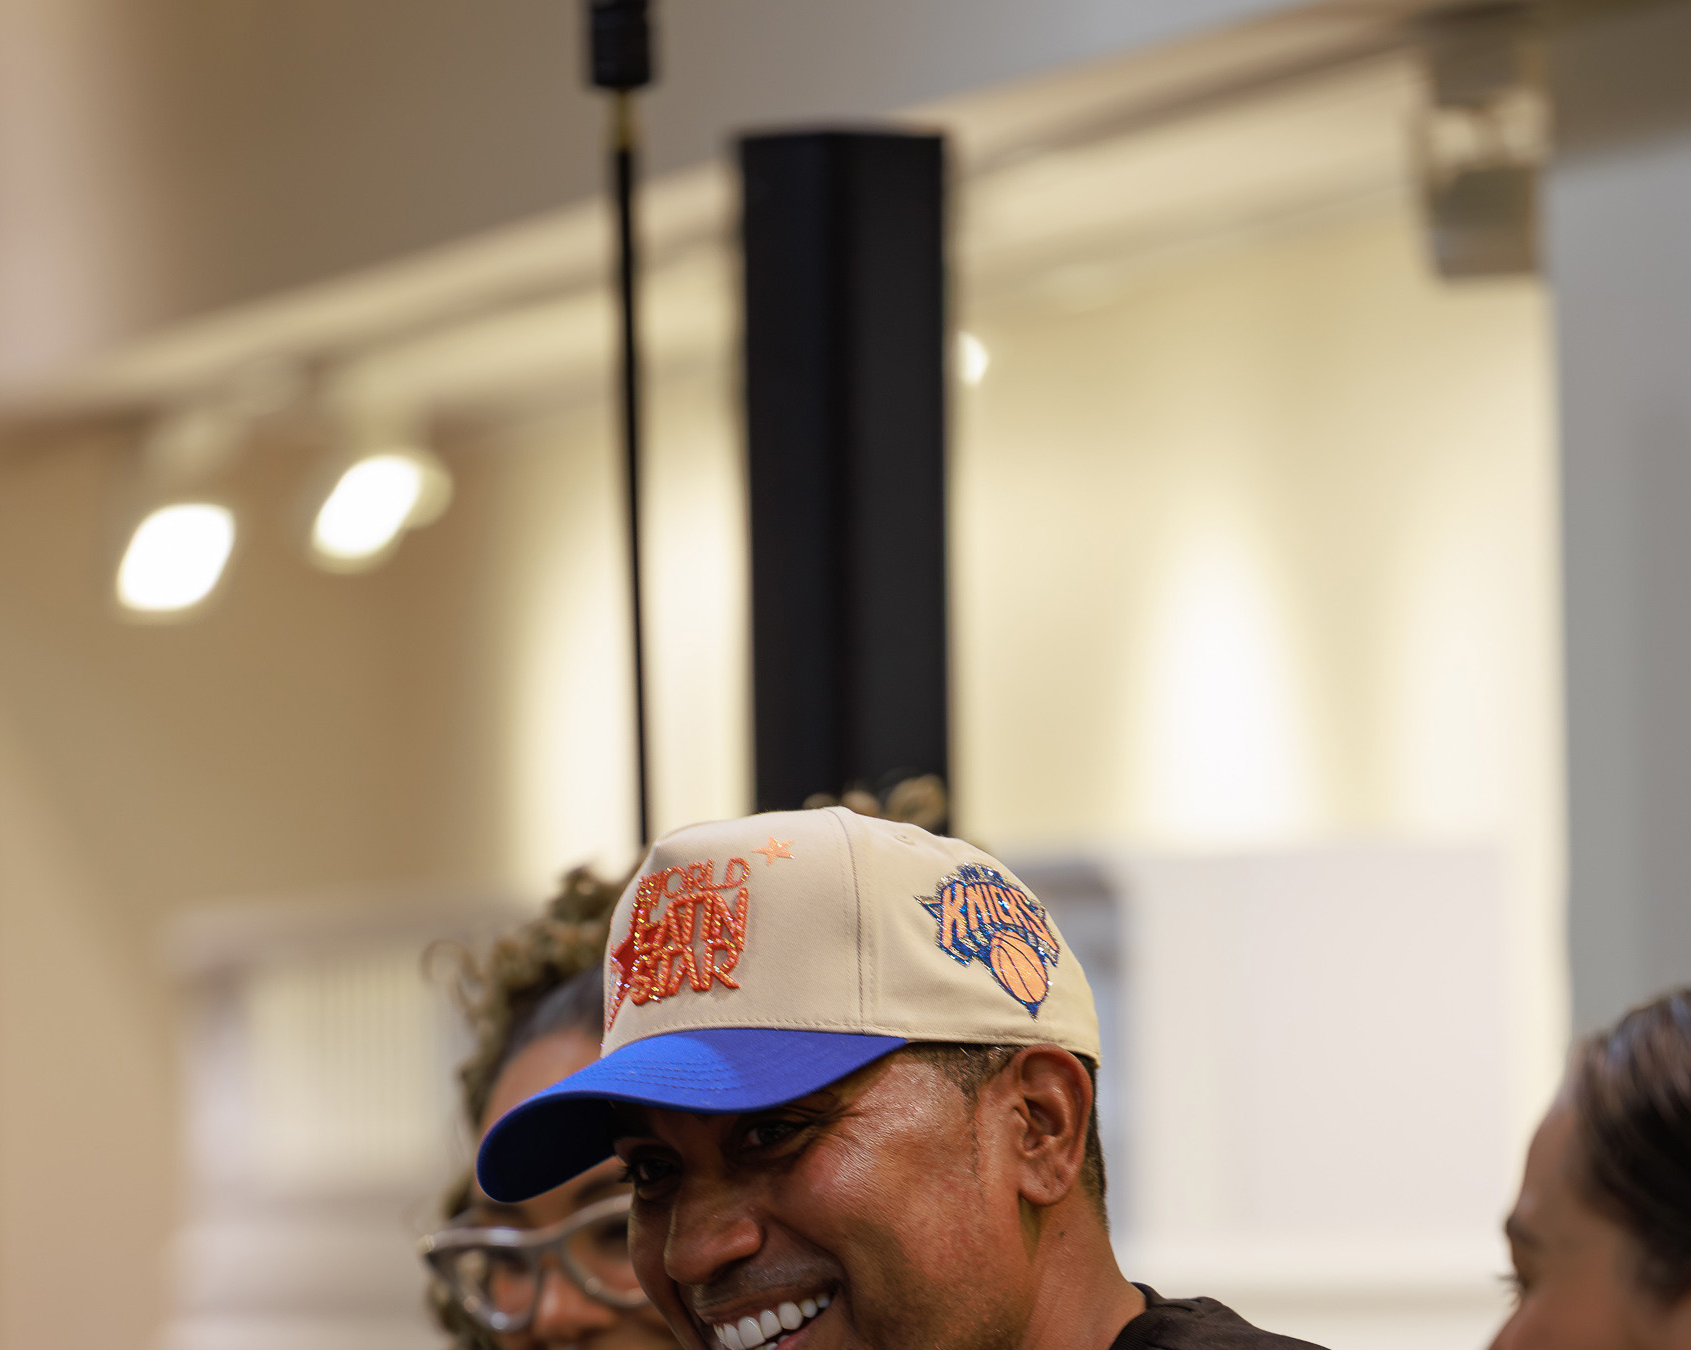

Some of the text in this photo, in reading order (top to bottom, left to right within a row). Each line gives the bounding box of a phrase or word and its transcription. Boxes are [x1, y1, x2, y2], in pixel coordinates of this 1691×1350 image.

[634, 857, 751, 907] WORLD
[938, 881, 1060, 953] KNICKS
[628, 938, 740, 1007] STAR
